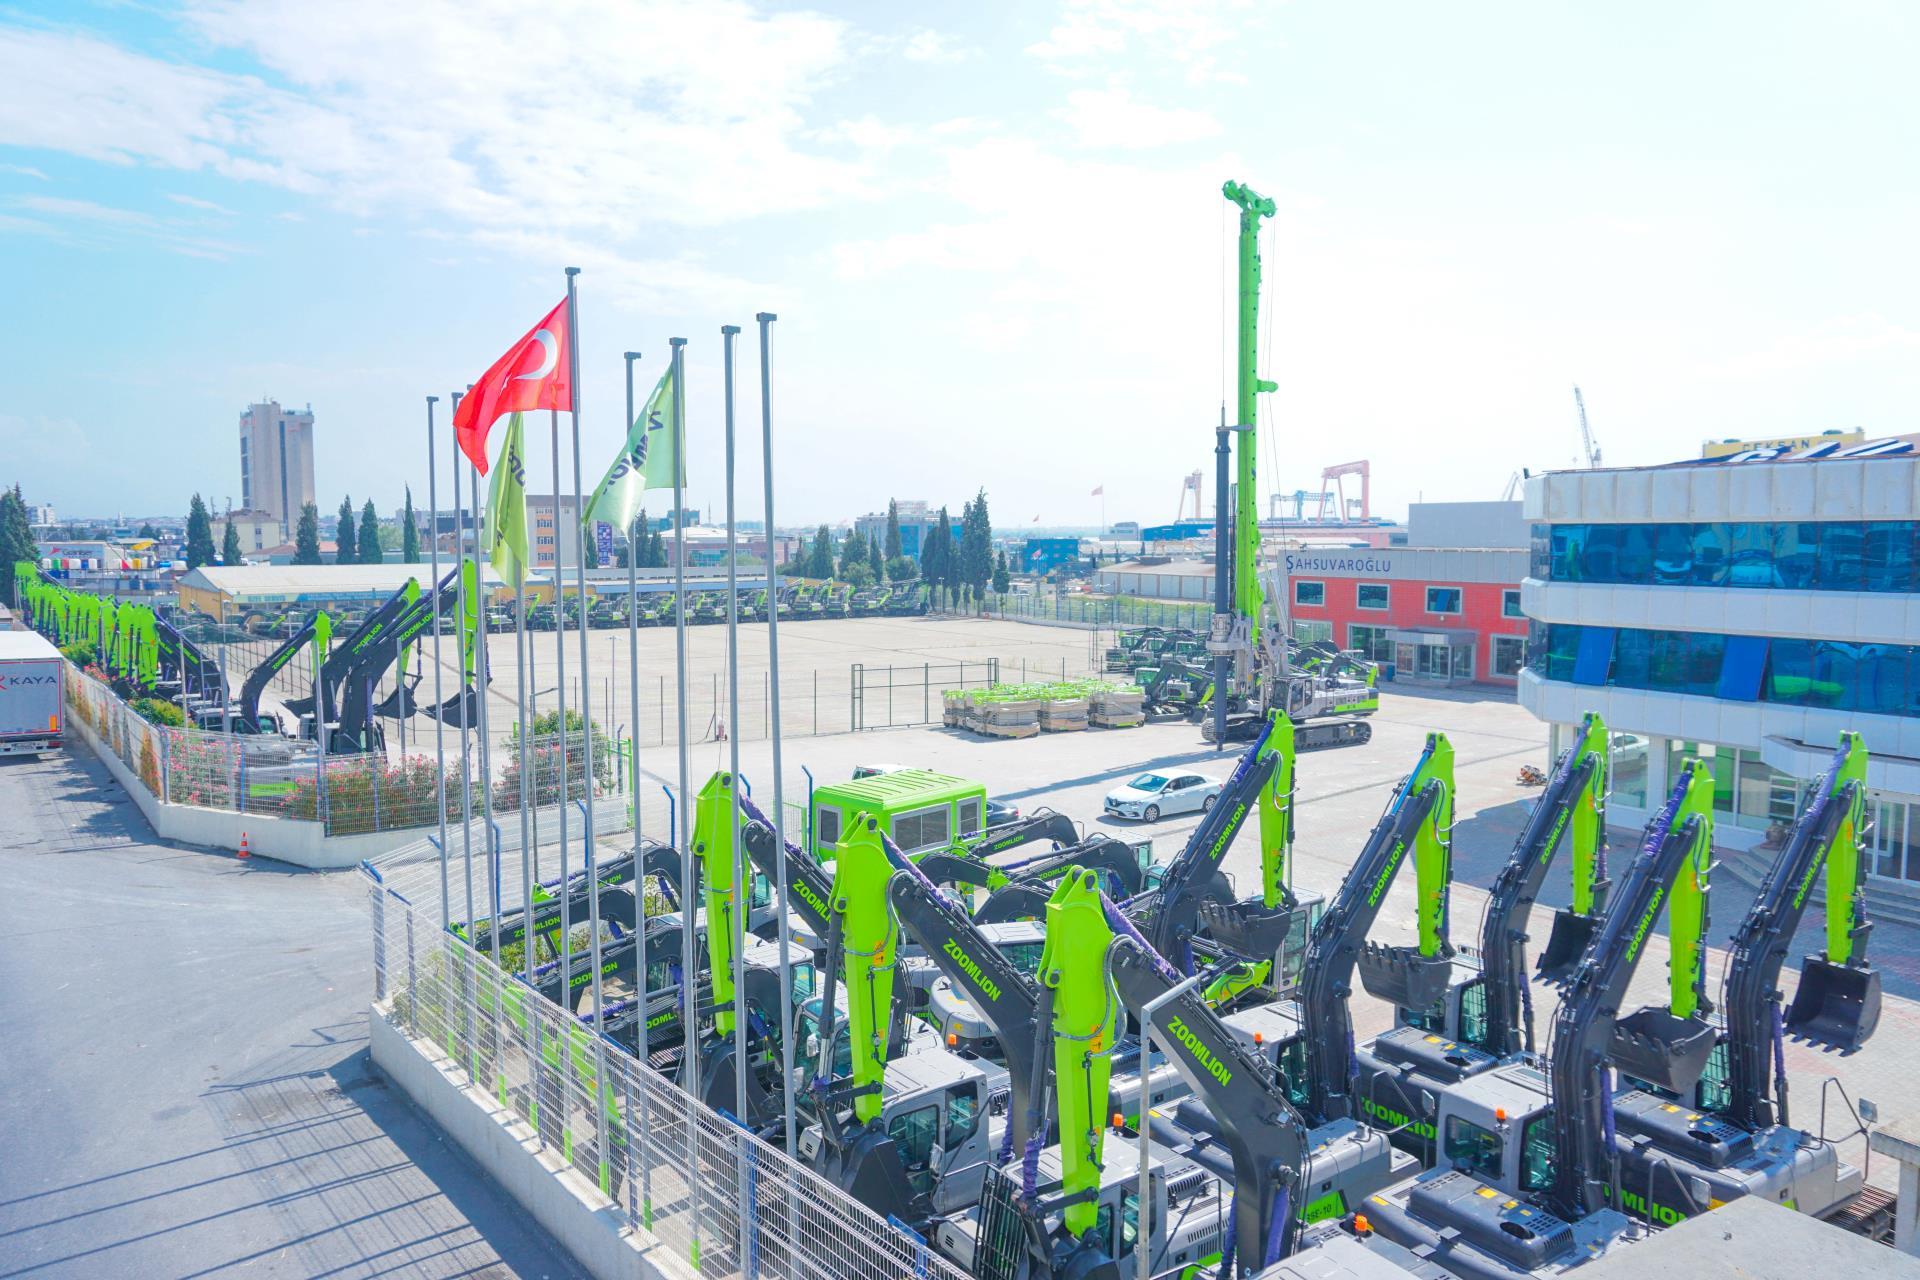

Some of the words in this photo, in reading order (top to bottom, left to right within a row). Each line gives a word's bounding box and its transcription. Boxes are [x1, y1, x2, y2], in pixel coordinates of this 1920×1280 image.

[1286, 555, 1391, 574] ŞAHSUVAROĞLU
[9, 676, 57, 685] KAYA
[1209, 803, 1246, 860] ZOOMLION
[1540, 807, 1569, 865] ZOOMLION
[1368, 841, 1406, 907] ZOOMLION
[1625, 887, 1664, 963] ZOOMLION
[943, 938, 1002, 1002] ZOOMLION
[1168, 1015, 1232, 1087] ZOOMLION
